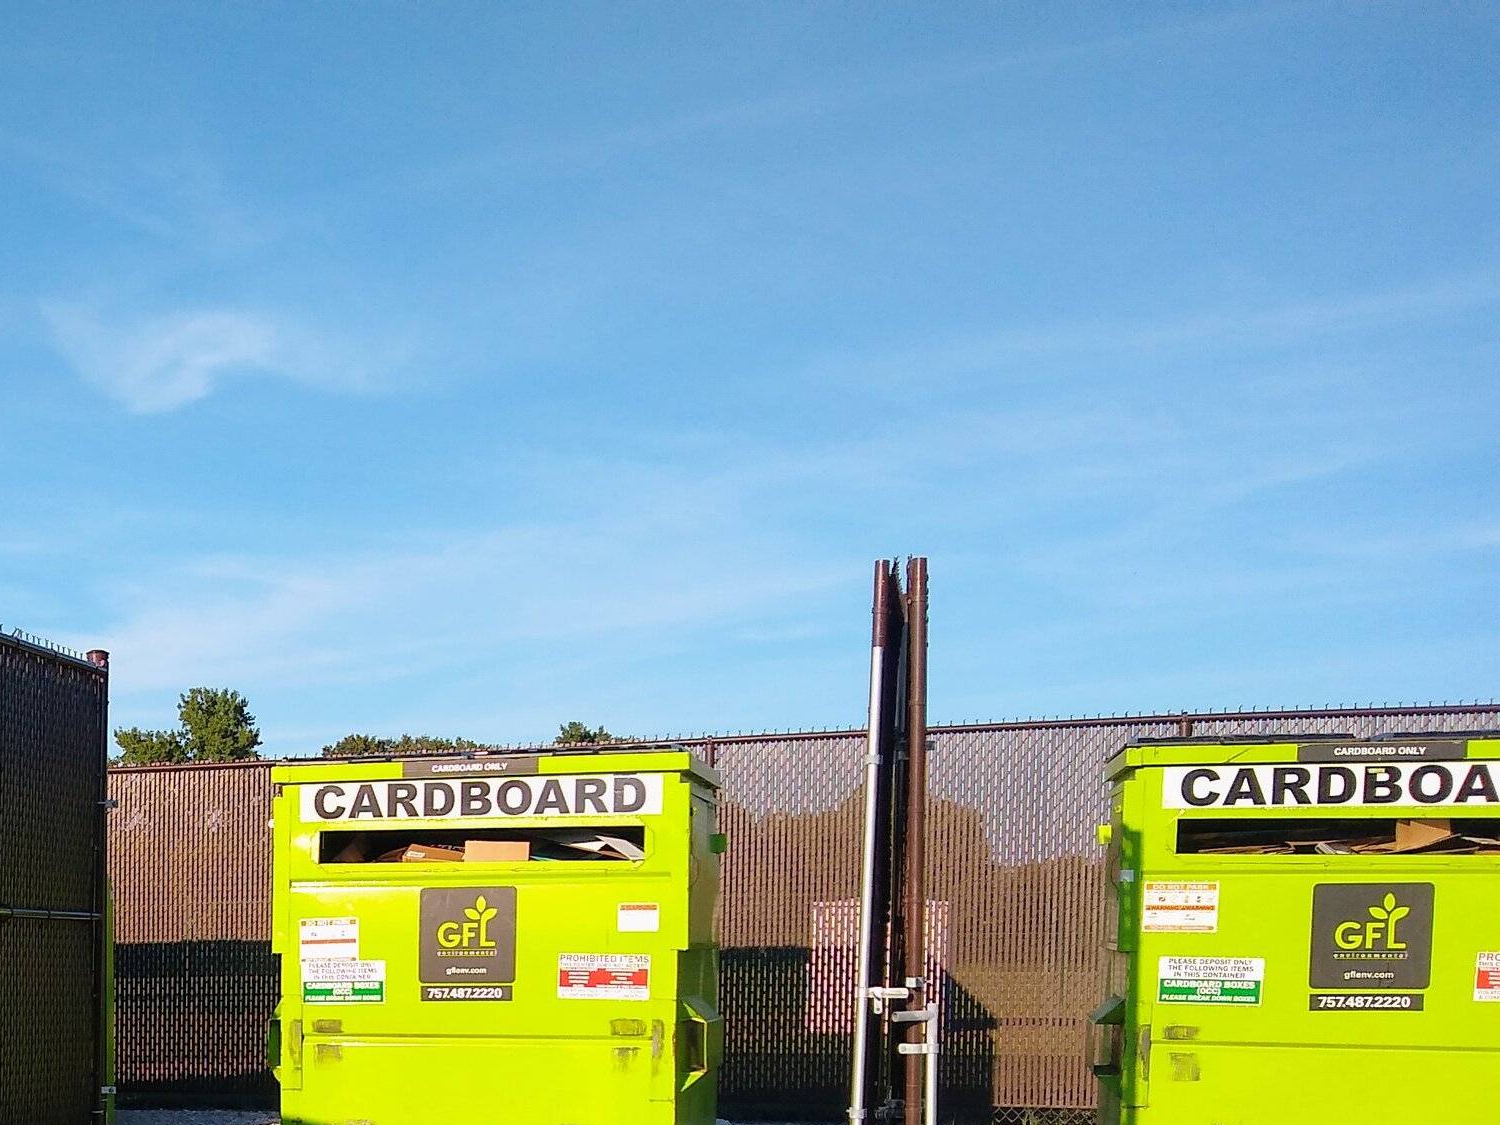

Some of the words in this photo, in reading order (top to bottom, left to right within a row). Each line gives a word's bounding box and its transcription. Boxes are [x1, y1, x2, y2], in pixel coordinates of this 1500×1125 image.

[1334, 747, 1396, 756] CARDBOARD
[1398, 746, 1426, 755] ONLY
[431, 763, 483, 773] CARDBOARD
[484, 762, 508, 771] ONLY
[1180, 764, 1500, 806] CARDBOA
[314, 777, 647, 819] CARDBOARD
[437, 908, 497, 948] GFL
[1334, 907, 1409, 950] GFL
[560, 954, 616, 963] PROHIBITED
[1344, 970, 1394, 980] gflenv.com
[1164, 980, 1222, 988] CARDBOARD
[427, 988, 503, 999] 757.487.2220
[1318, 996, 1411, 1008] 757.487.2220
